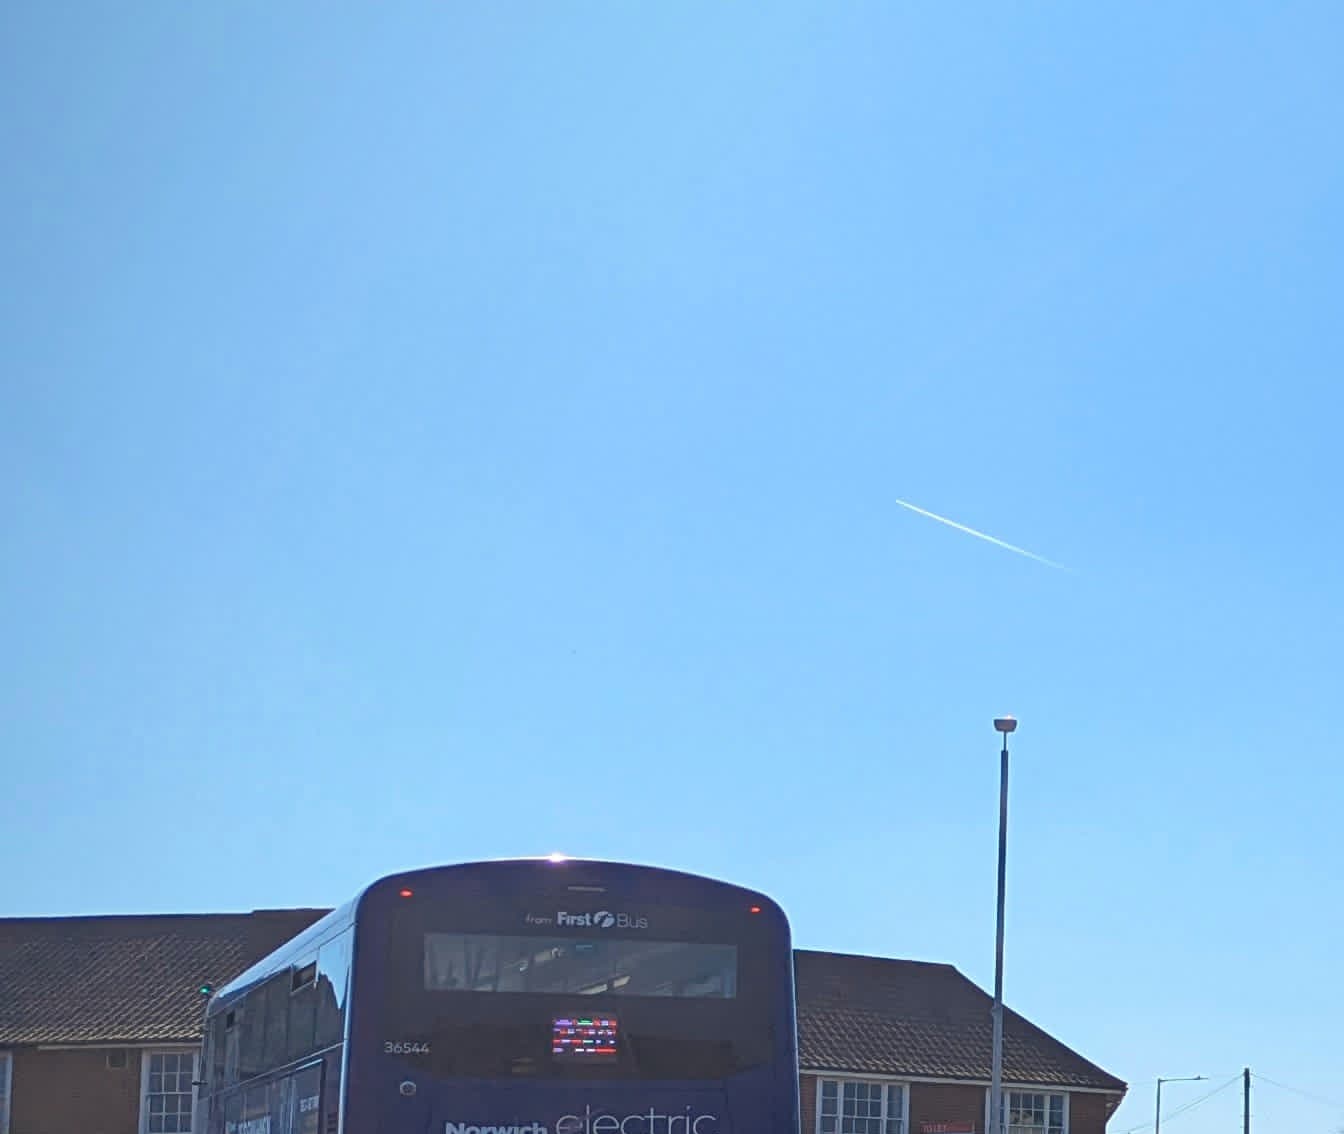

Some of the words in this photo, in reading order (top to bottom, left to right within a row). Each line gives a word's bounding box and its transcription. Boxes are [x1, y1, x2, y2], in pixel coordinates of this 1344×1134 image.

[525, 913, 552, 925] from
[556, 912, 593, 927] First
[616, 913, 649, 929] Bus
[384, 1041, 431, 1054] 36544
